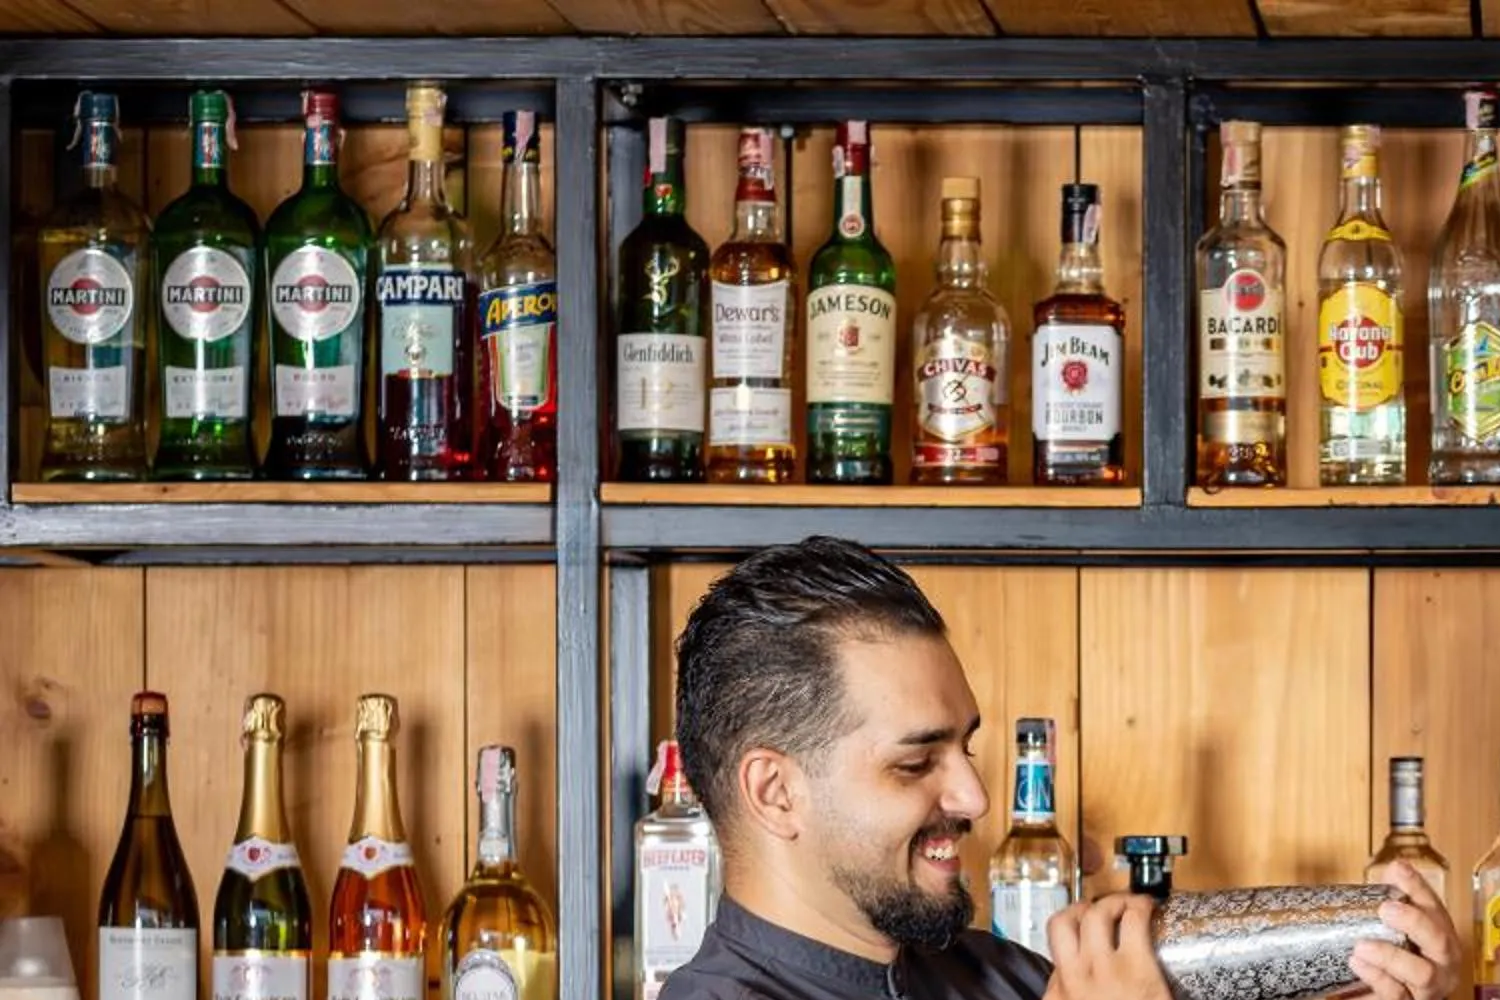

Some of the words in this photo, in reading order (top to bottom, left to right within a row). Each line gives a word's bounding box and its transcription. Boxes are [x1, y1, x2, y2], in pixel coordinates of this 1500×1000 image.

[52, 288, 125, 305] MARTINI
[168, 286, 242, 303] MARTINI
[278, 286, 350, 302] MARTINI
[378, 275, 463, 300] CAMPARI
[809, 293, 891, 320] JAMESON
[1041, 338, 1067, 367] JM
[1070, 335, 1111, 367] BEAM
[643, 849, 706, 868] BEEFEATER
